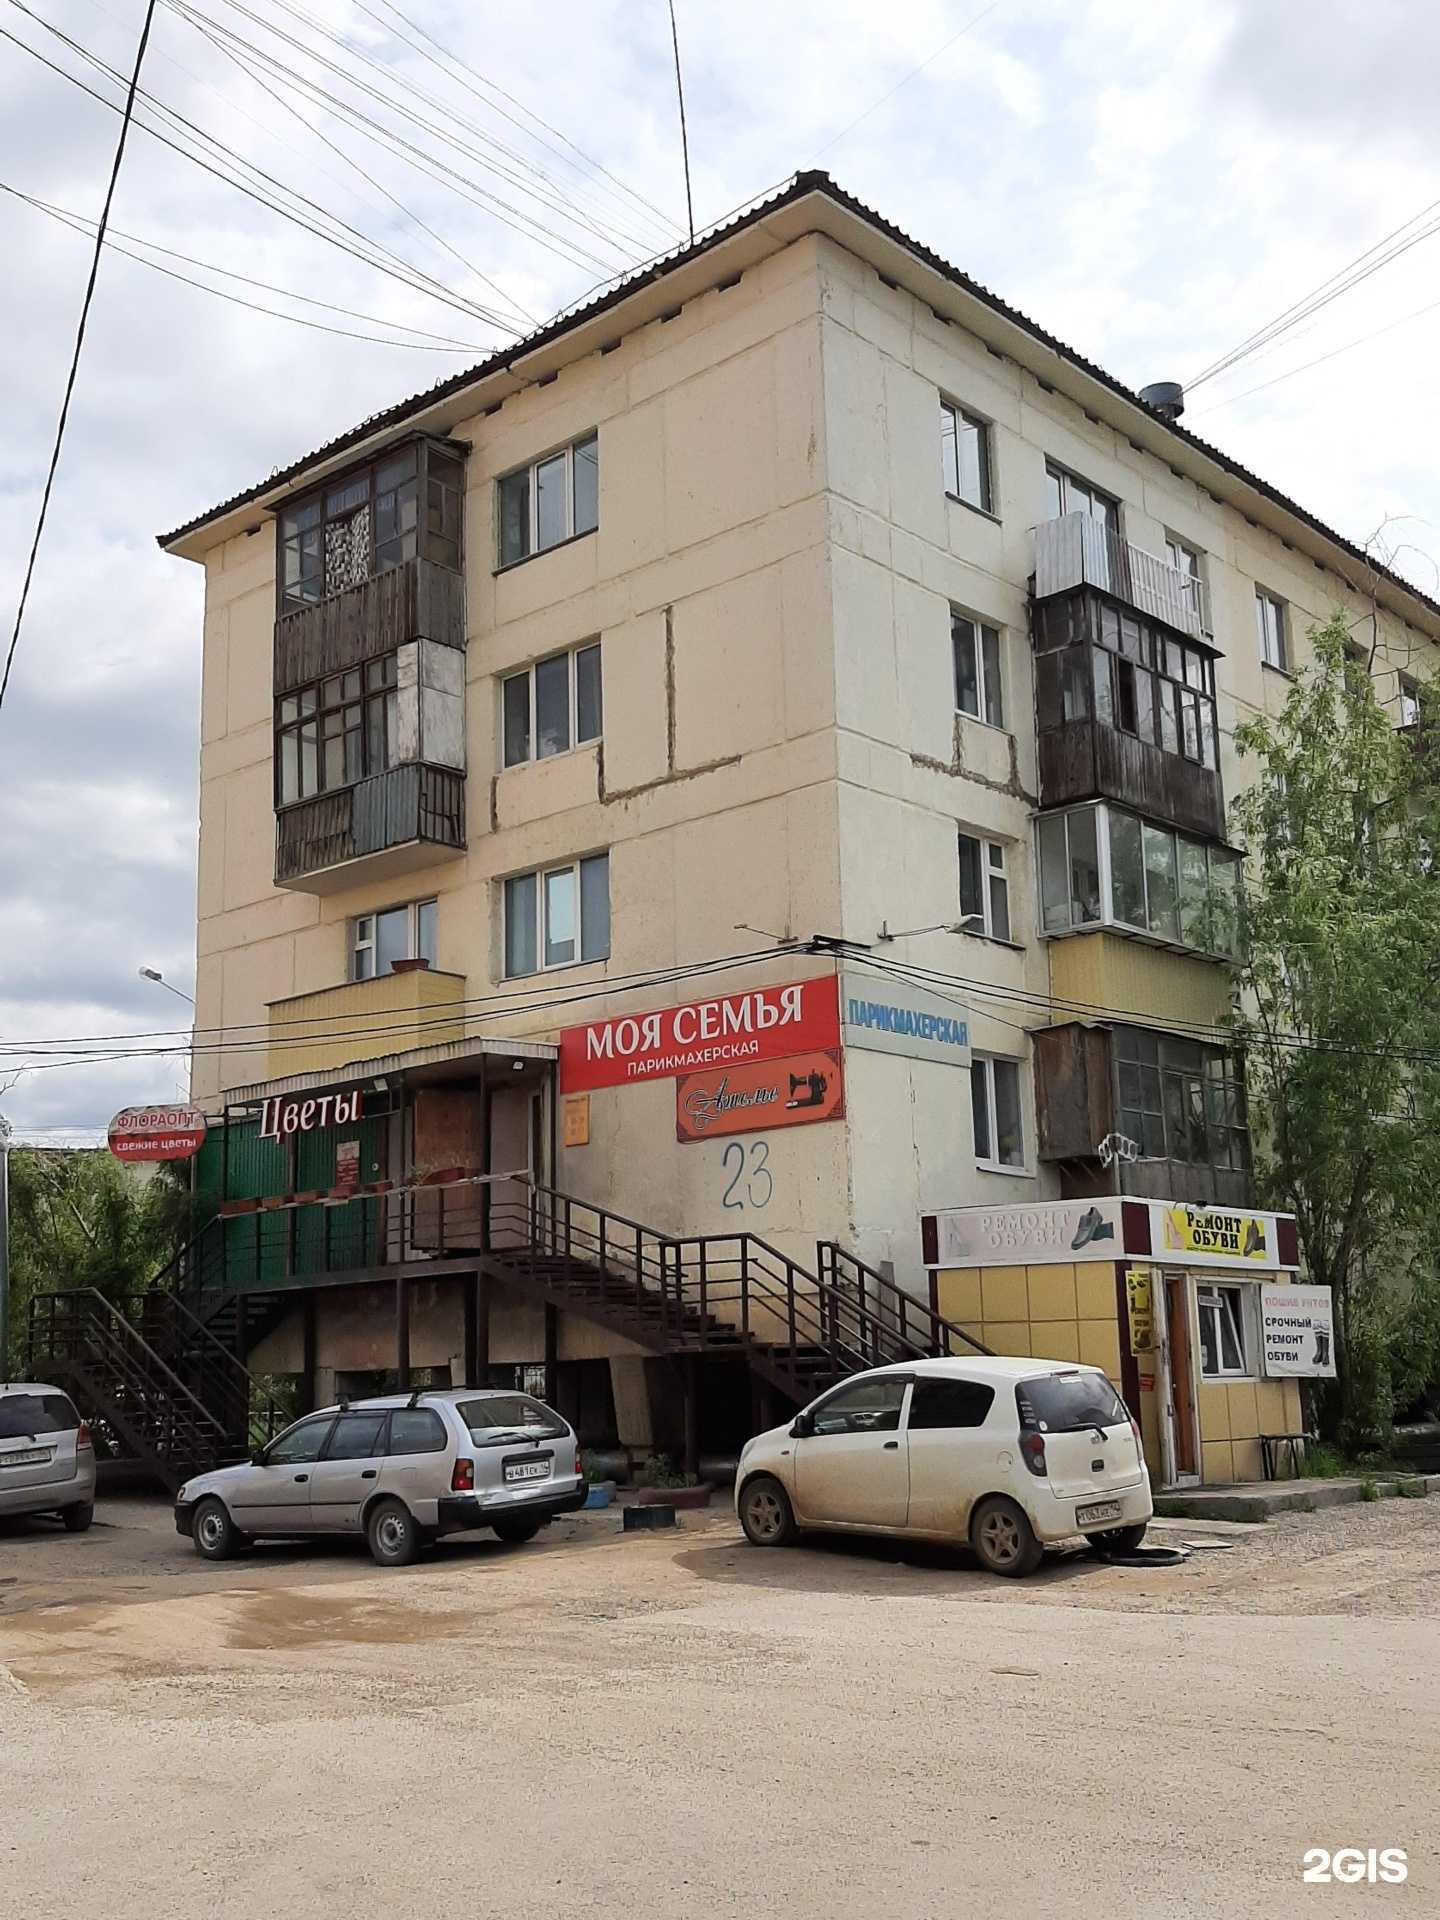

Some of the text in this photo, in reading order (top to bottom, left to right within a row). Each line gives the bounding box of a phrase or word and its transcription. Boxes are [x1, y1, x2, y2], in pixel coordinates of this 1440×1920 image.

[587, 985, 804, 1060] МОЯ СЕМЬЯ
[848, 999, 968, 1046] ПАРИКМАХЕРСКАЯ
[627, 1040, 759, 1076] ПАРИКМАХЕРСКАЯ
[258, 1091, 359, 1143] Цветы
[161, 1138, 197, 1150] цветы
[723, 1141, 772, 1209] 23
[1193, 1230, 1239, 1249] ОБУВИ
[1265, 1317, 1312, 1328] СРОЧНЫЙ
[1266, 1335, 1304, 1344] РЕМОНТ
[1267, 1352, 1299, 1361] ОБУВИ
